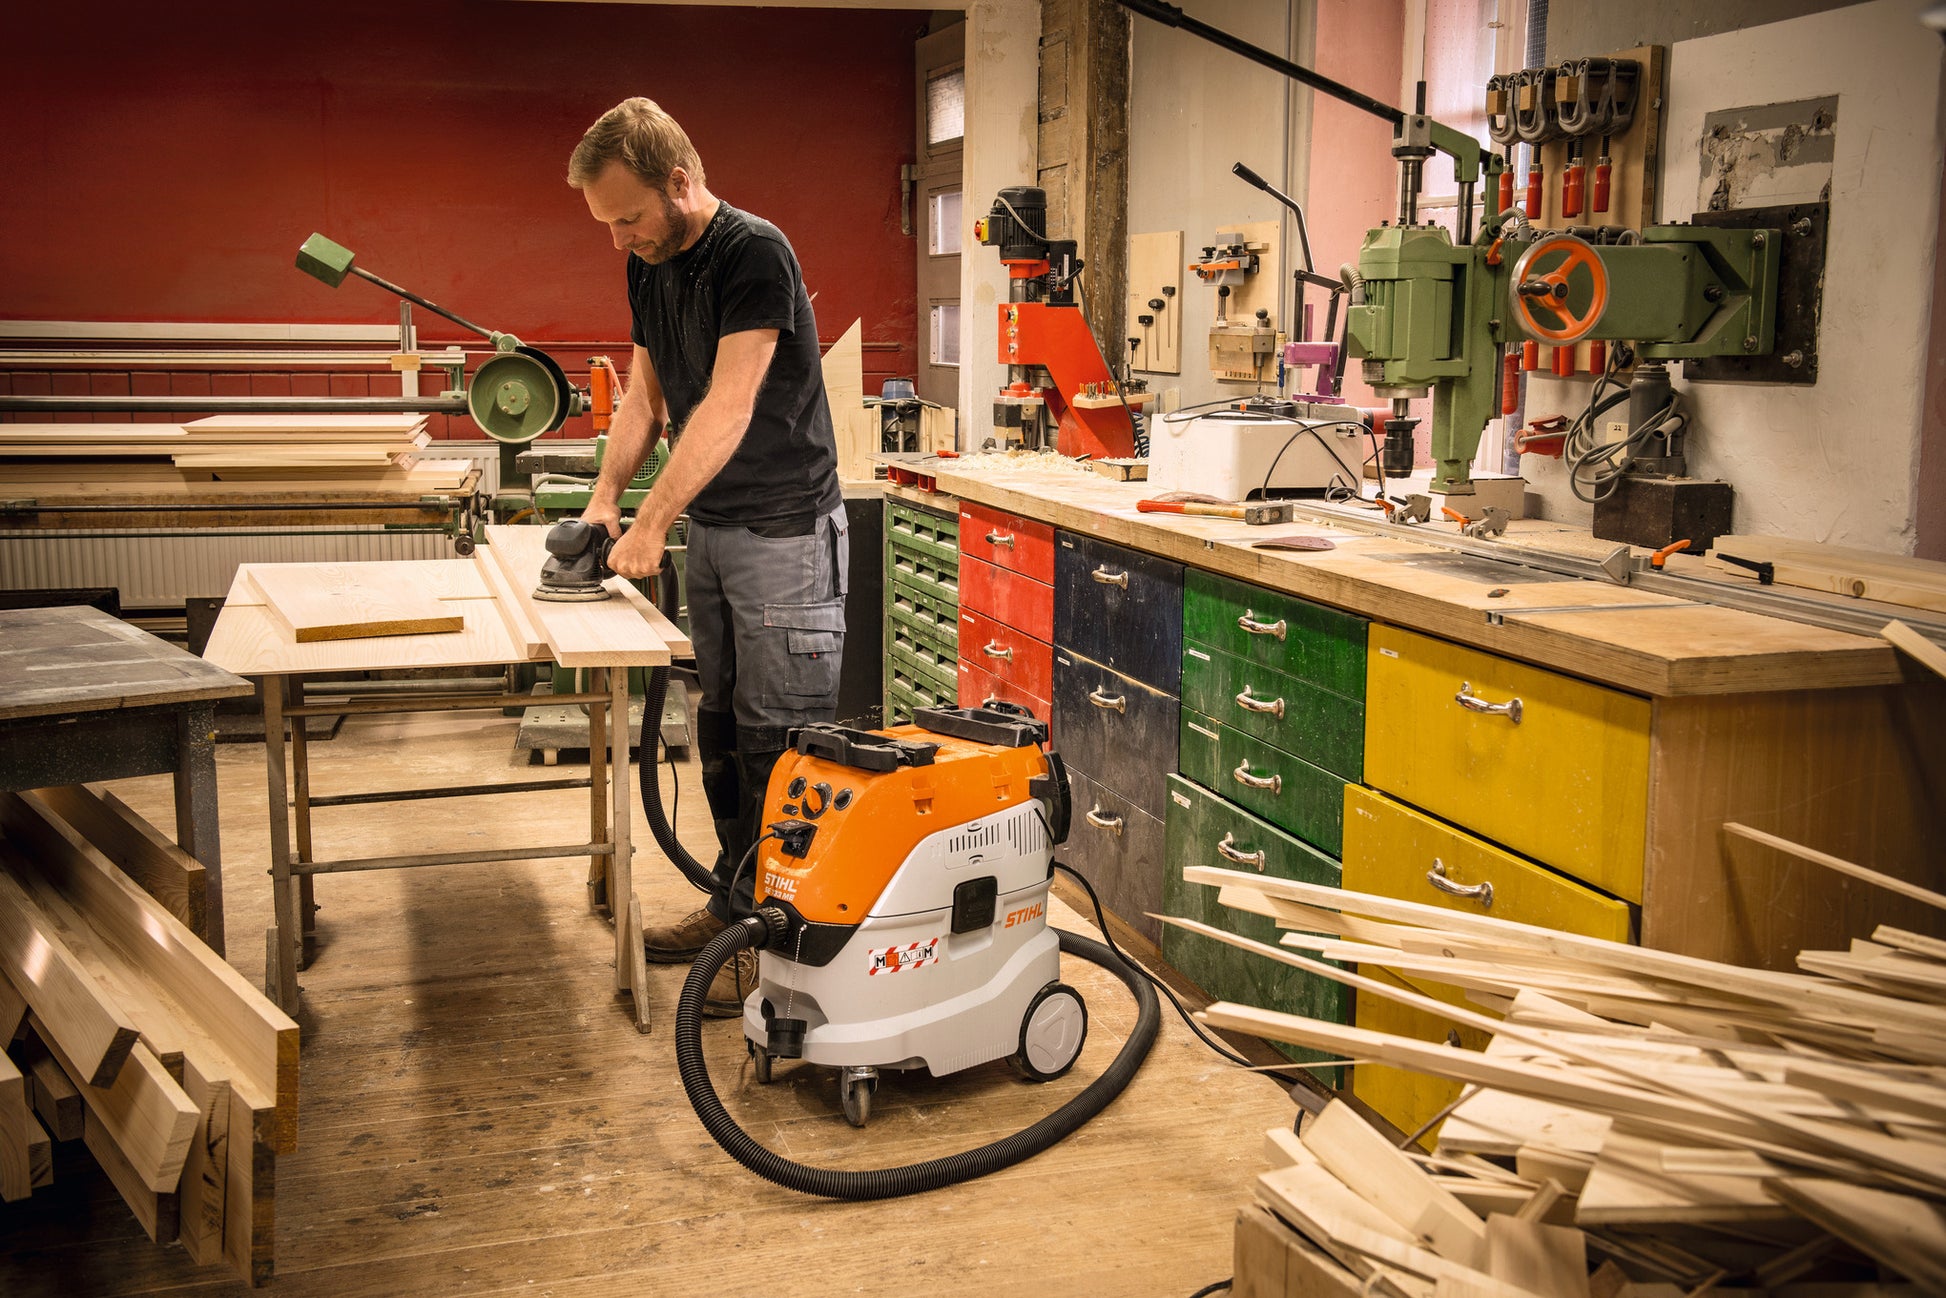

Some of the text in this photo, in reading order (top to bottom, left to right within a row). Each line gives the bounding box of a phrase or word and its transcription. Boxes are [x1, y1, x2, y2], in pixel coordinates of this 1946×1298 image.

[764, 872, 797, 893] STIHL
[1004, 902, 1043, 928] STIHL
[876, 947, 933, 967] M M
